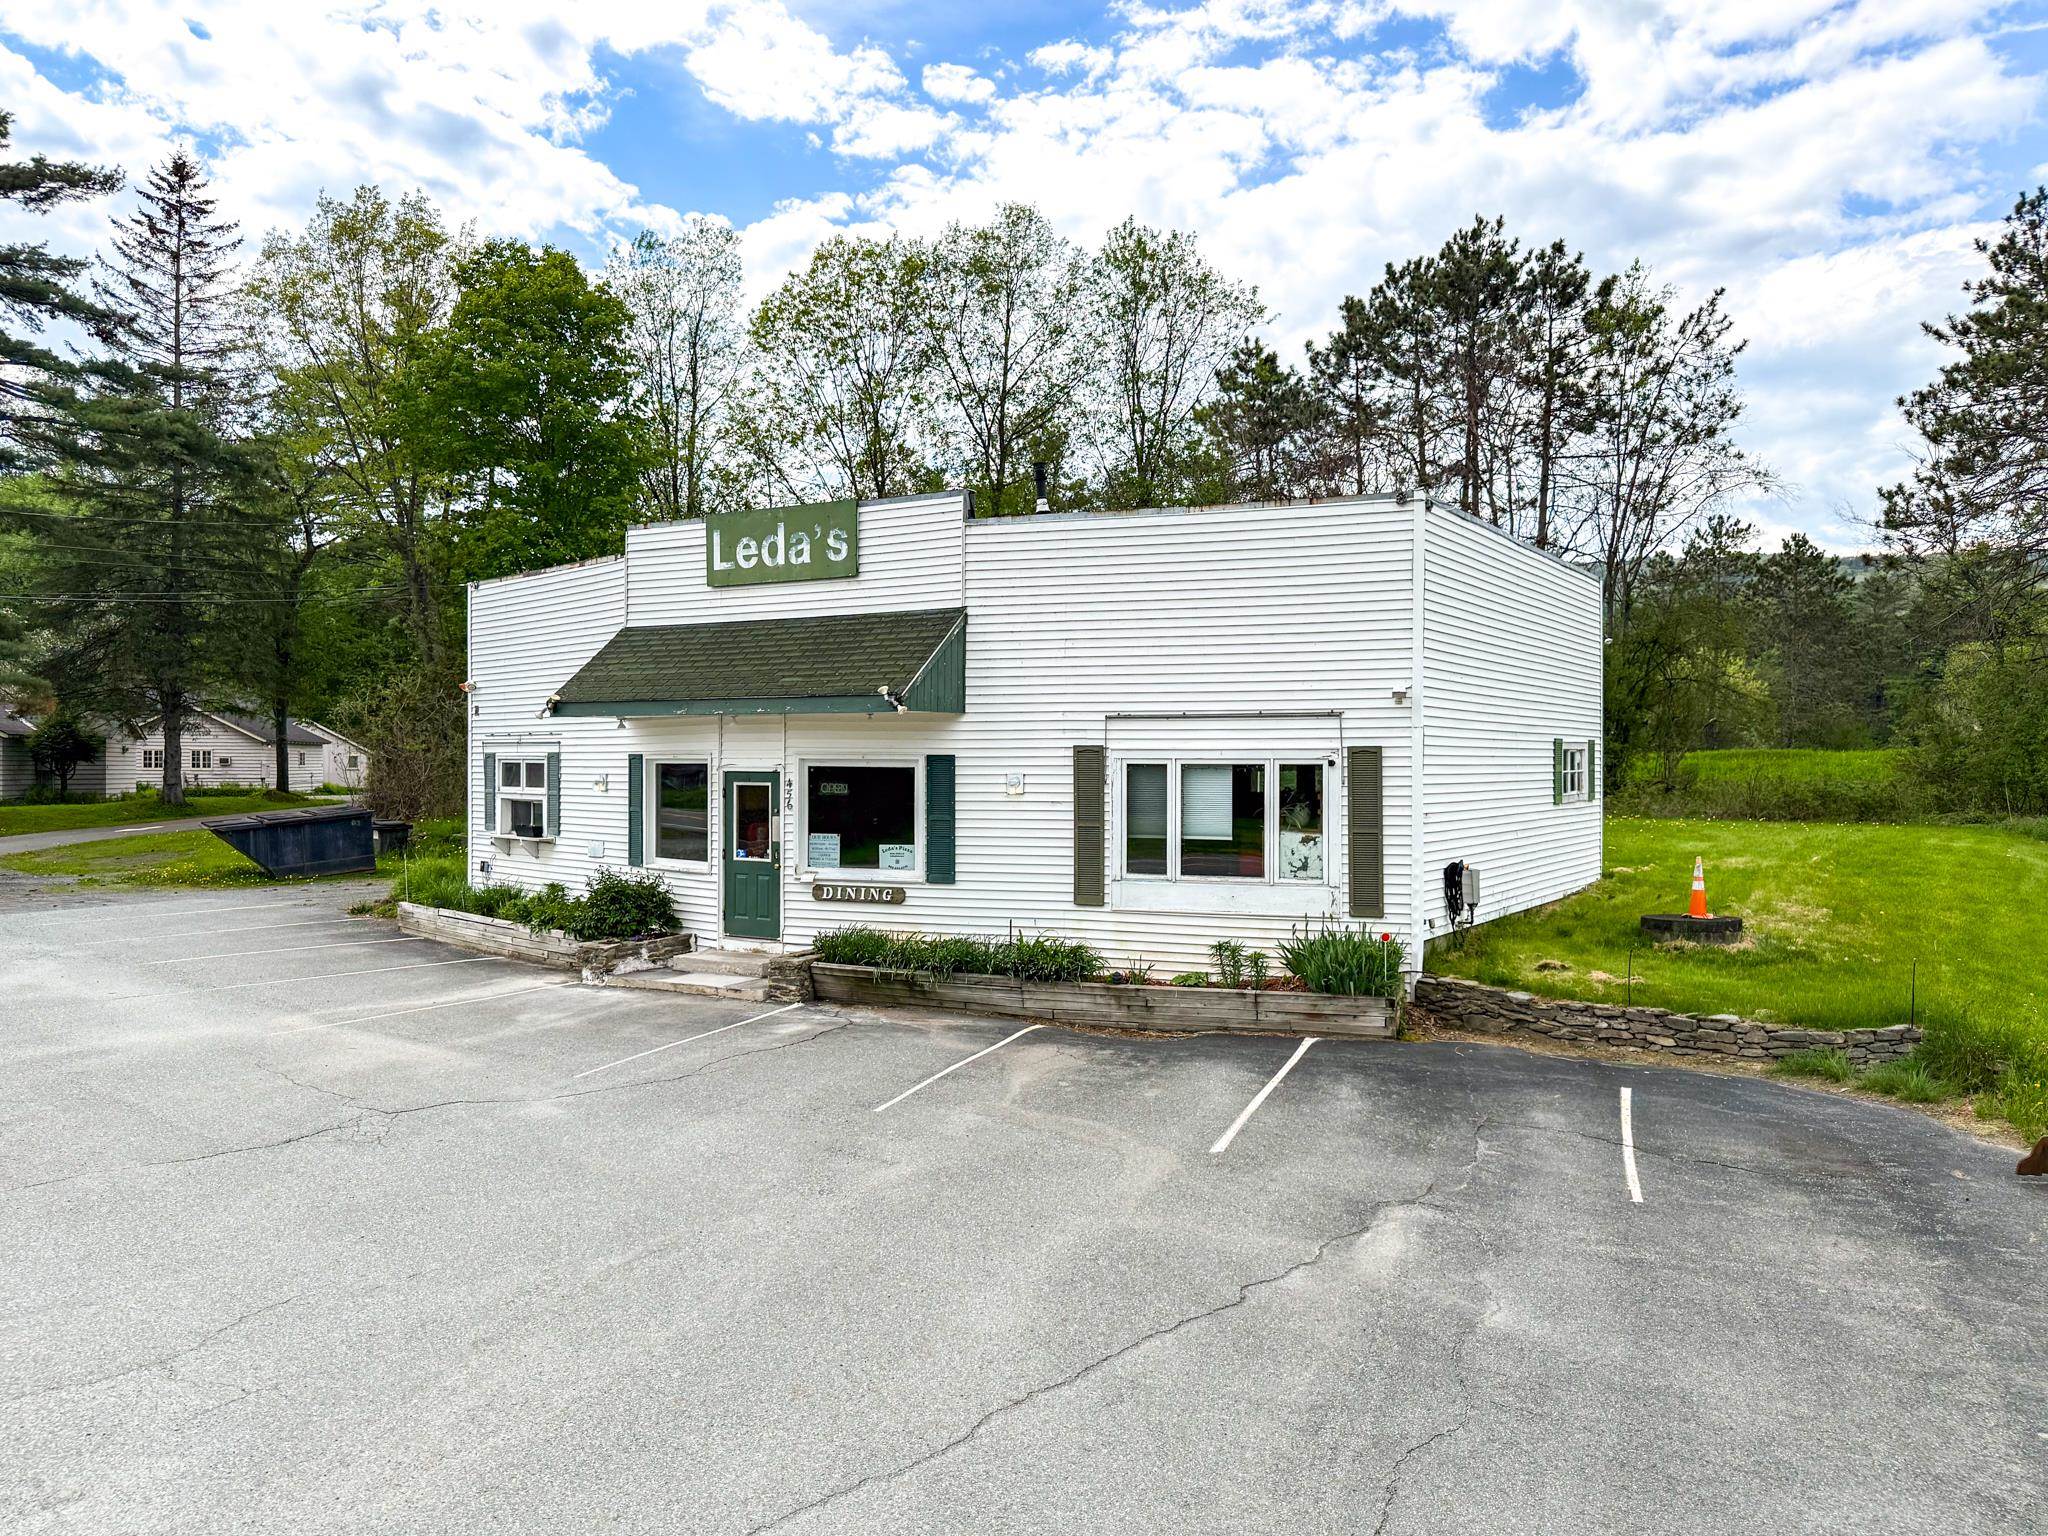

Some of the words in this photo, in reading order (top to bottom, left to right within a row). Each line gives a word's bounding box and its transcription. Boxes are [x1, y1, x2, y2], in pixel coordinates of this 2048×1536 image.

[712, 521, 849, 571] Leda's
[786, 777, 794, 811] 456
[820, 782, 848, 794] OPEN
[881, 845, 898, 854] Leda's
[821, 886, 893, 901] DINING
